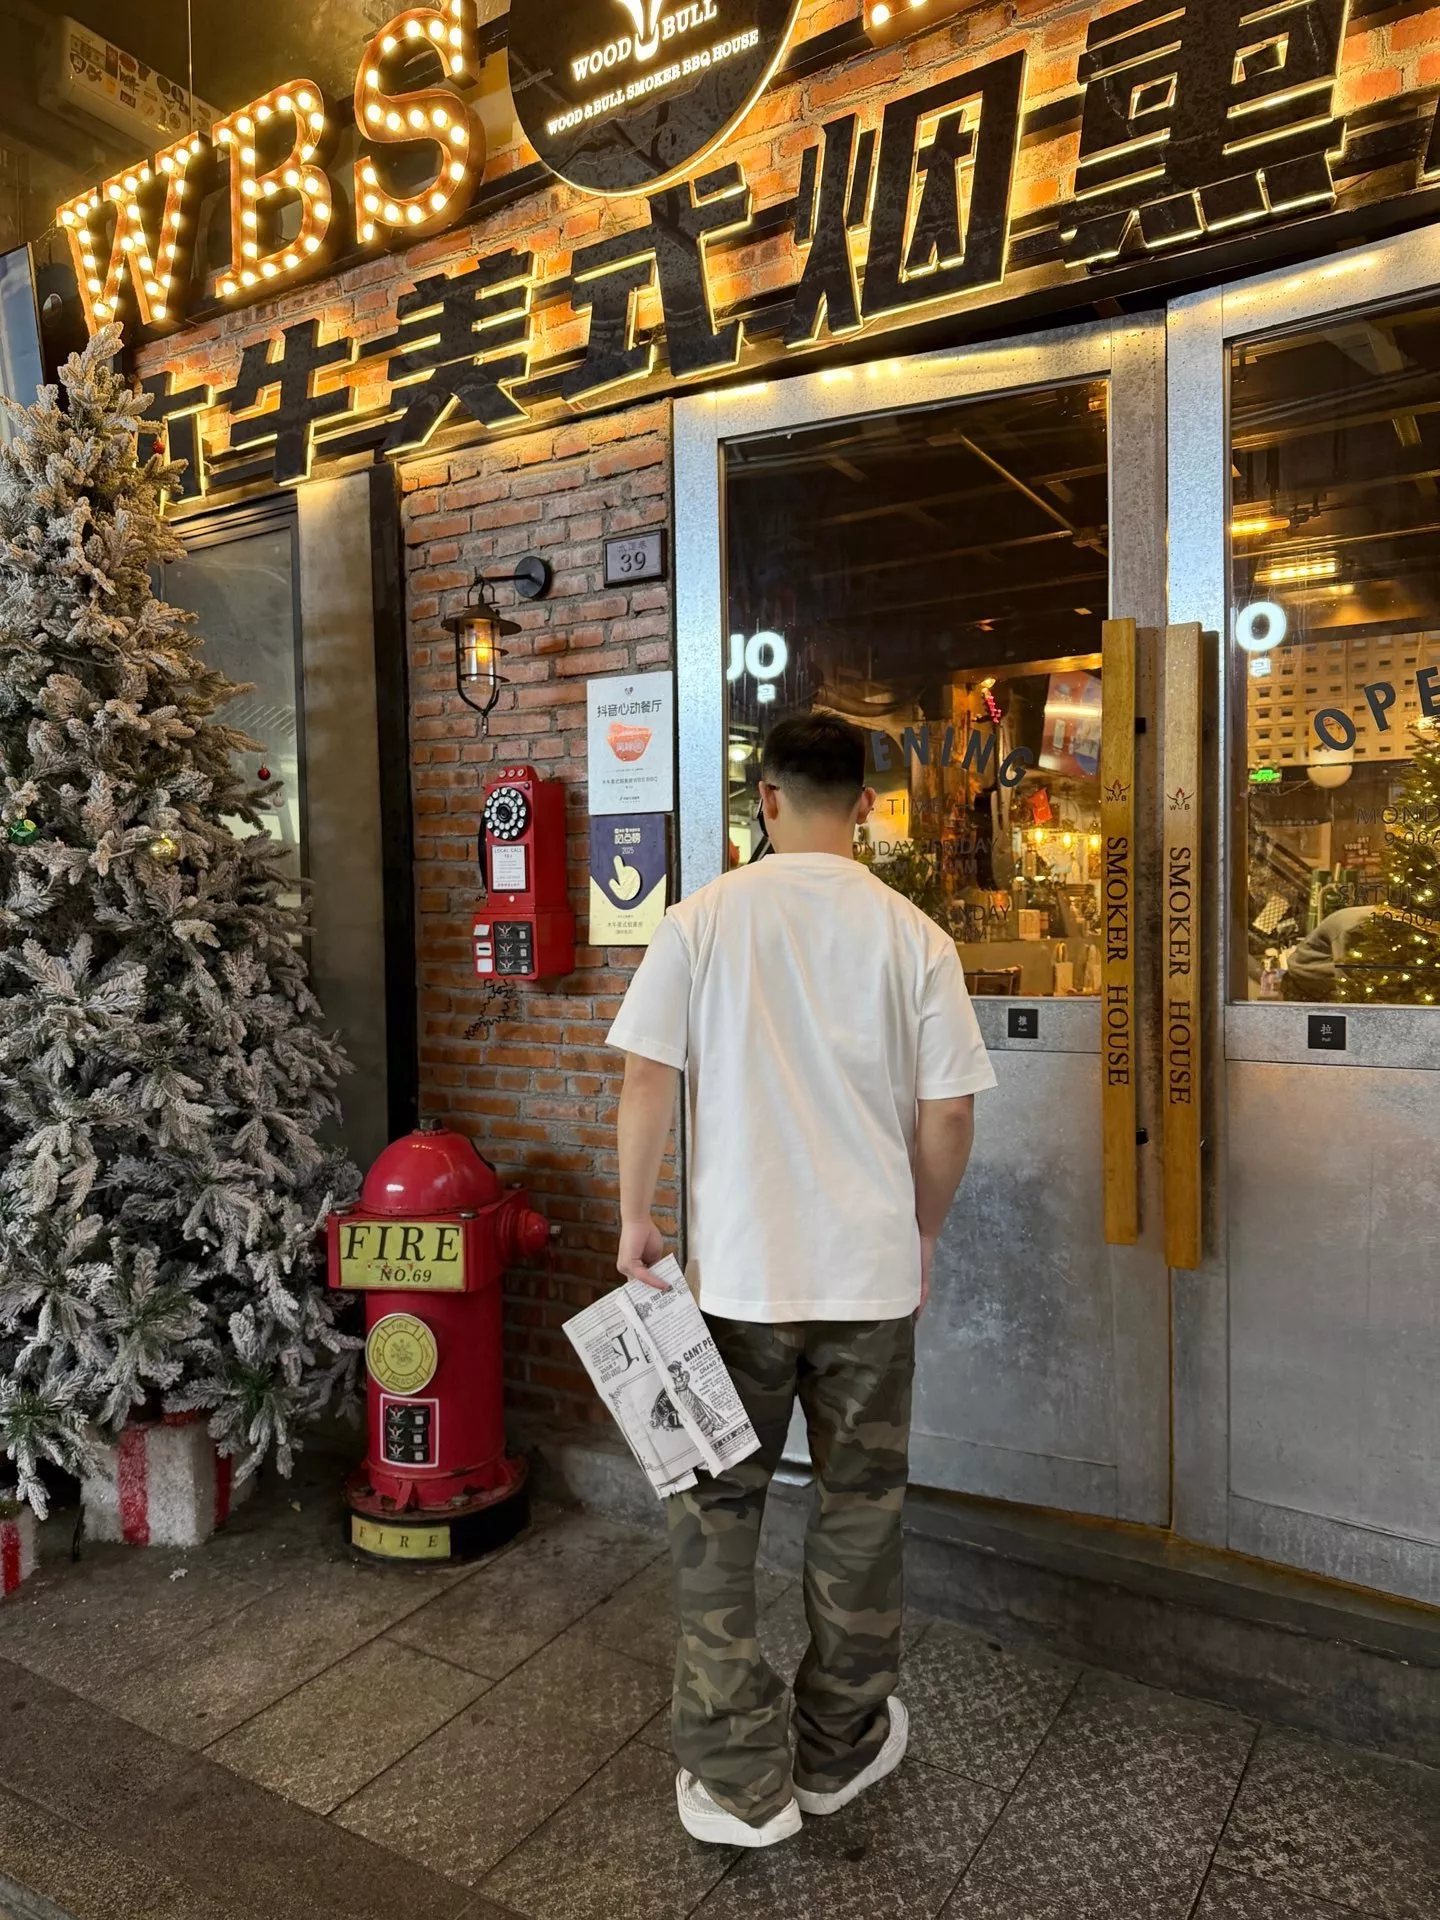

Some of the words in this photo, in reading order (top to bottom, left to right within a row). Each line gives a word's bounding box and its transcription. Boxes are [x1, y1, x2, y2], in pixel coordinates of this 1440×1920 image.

[571, 37, 632, 82] WOOD
[661, 0, 718, 41] BULL
[547, 108, 583, 136] WOOD
[626, 64, 681, 101] SMOKER
[682, 52, 712, 77] BBQ
[712, 29, 760, 63] HOUSE
[56, 0, 480, 333] WBS
[620, 551, 646, 572] 39
[597, 699, 662, 718] 抖音心动餐厅
[871, 726, 1034, 788] ENING
[1106, 836, 1129, 964] SMOKER
[1168, 847, 1191, 979] SMOKER
[1107, 984, 1130, 1086] HOUSE
[1168, 1000, 1191, 1104] HOUSE
[1320, 1023, 1333, 1036] 拉
[342, 1224, 461, 1263] FIRE
[379, 1267, 432, 1284] NO.69
[683, 1342, 704, 1362] GANT
